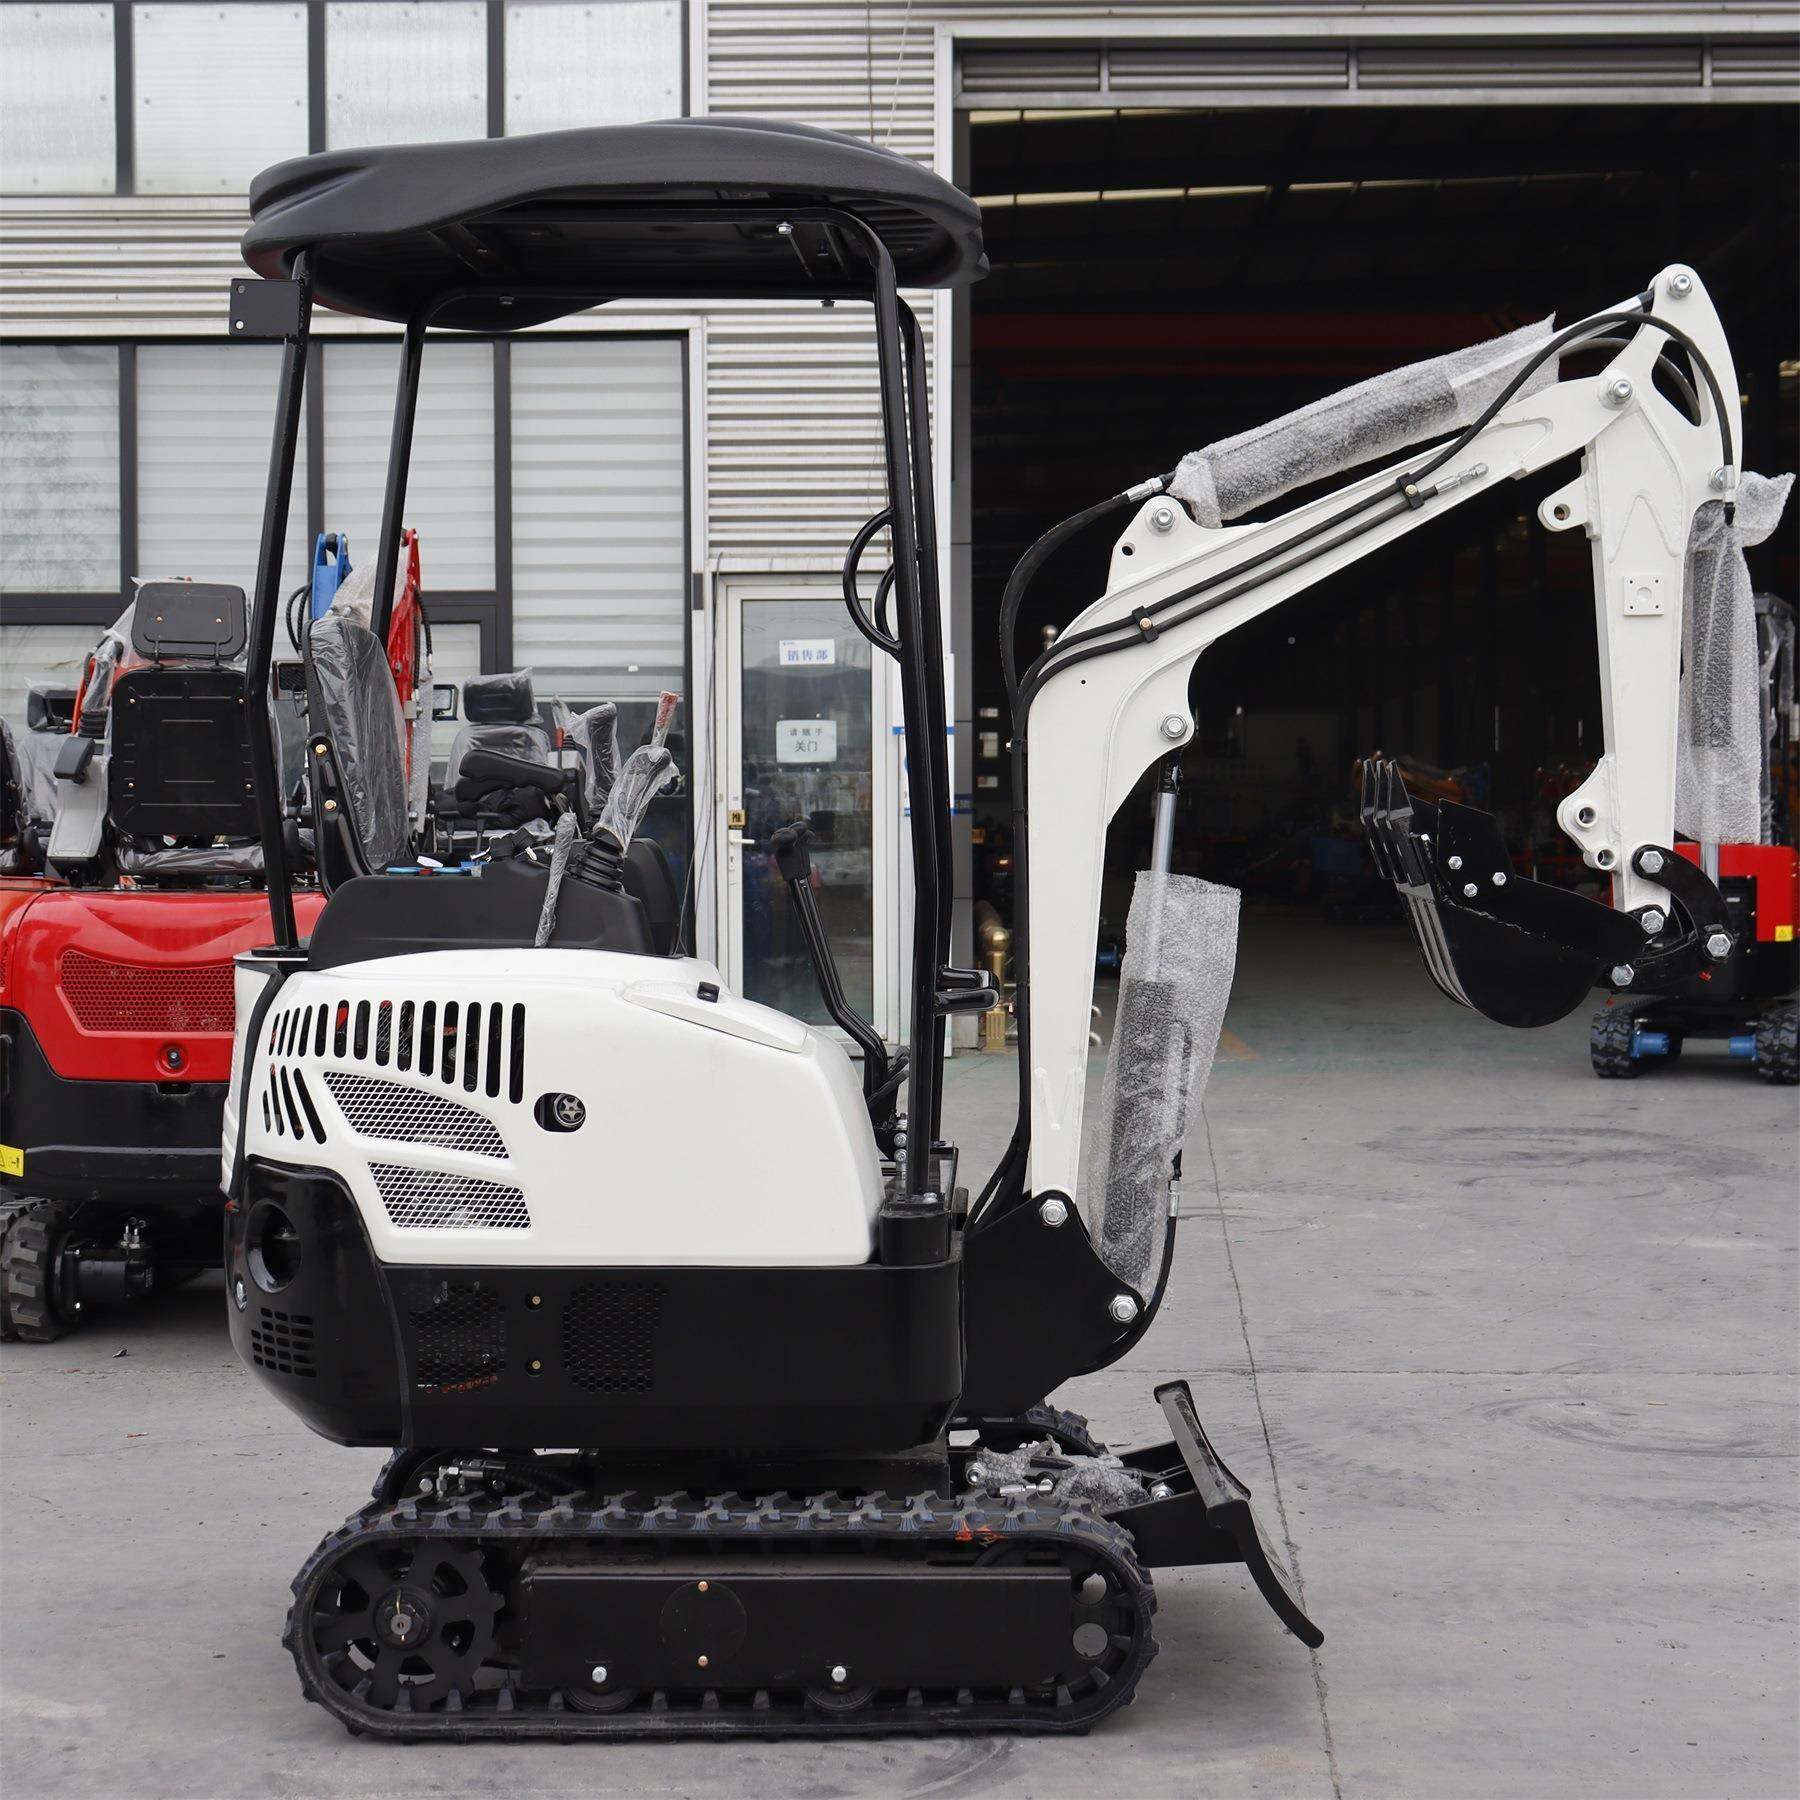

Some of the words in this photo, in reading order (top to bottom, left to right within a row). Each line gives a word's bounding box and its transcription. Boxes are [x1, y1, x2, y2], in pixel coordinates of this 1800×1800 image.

[787, 648, 829, 661] 销售部
[794, 740, 818, 752] 关门
[732, 812, 742, 823] 推
